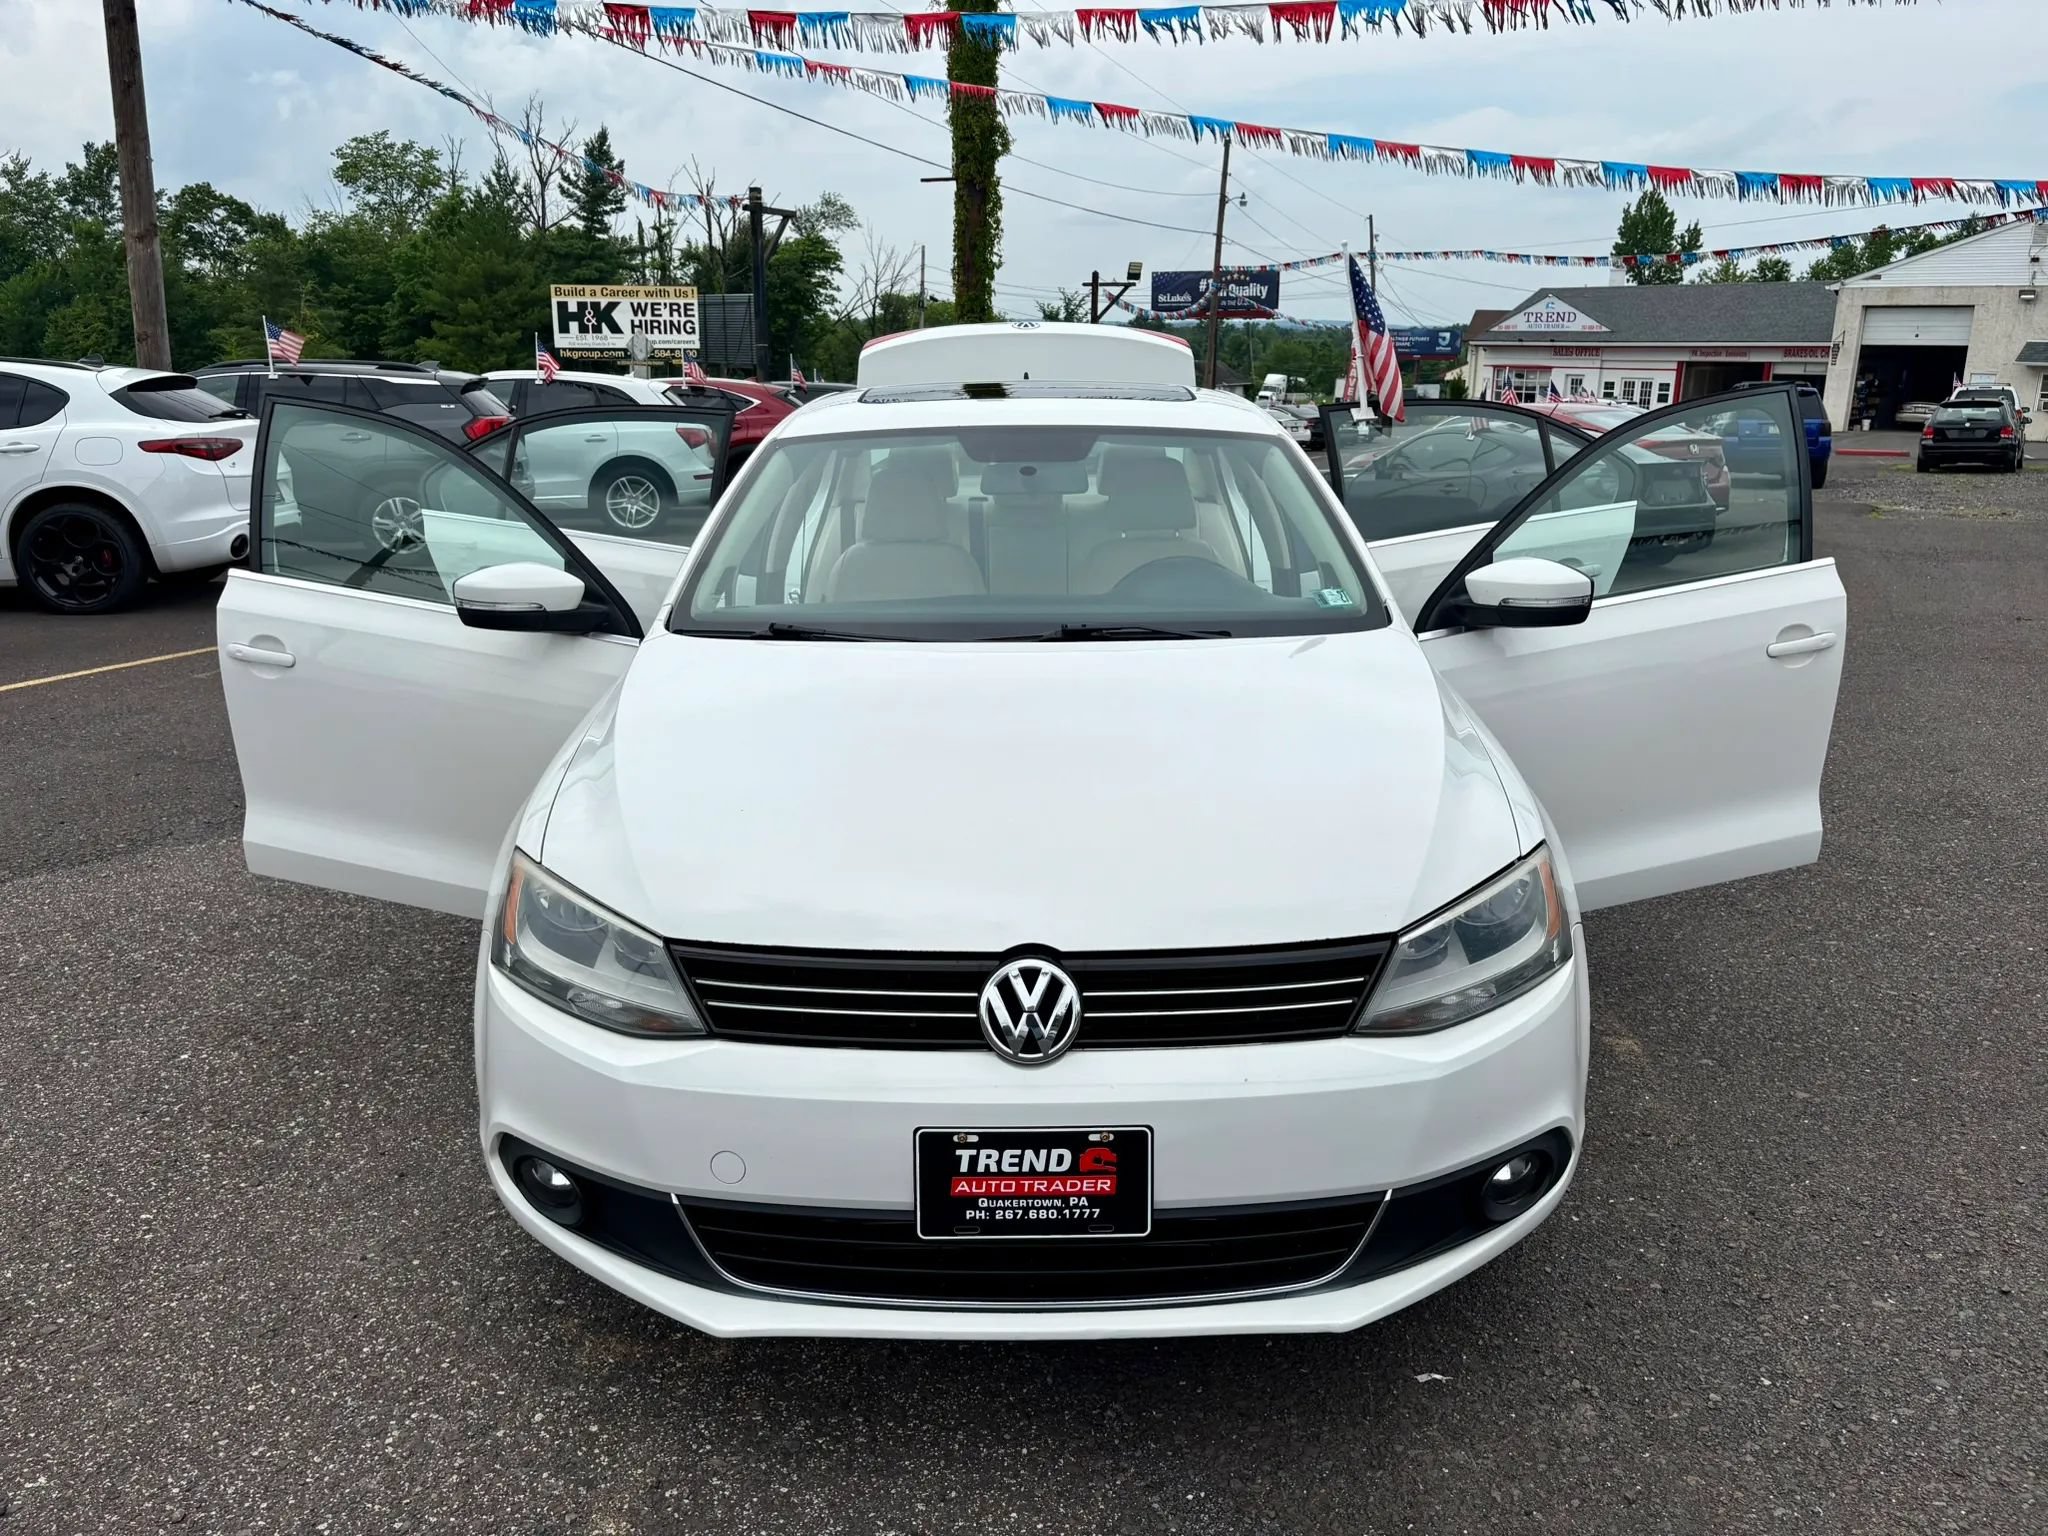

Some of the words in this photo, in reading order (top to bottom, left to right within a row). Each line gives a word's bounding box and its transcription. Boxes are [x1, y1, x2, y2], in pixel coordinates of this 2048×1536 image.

[554, 286, 586, 297] Build
[590, 289, 597, 297] a
[600, 287, 639, 298] Career
[644, 287, 671, 298] with
[1228, 283, 1268, 299] Quality
[630, 302, 695, 318] WE'RE
[557, 301, 624, 334] H&K
[1524, 311, 1577, 323] TREND
[630, 319, 696, 335] HIRING
[560, 349, 625, 360] hkgroup.com
[1552, 347, 1573, 357] SALES
[1575, 347, 1600, 357] OFFICE
[955, 1148, 1073, 1173] TREND
[978, 1197, 1066, 1209] QUAKERTOWN,
[1069, 1196, 1089, 1207] PA
[965, 1209, 991, 1220] PH:
[995, 1208, 1101, 1220] 267.680.1777
